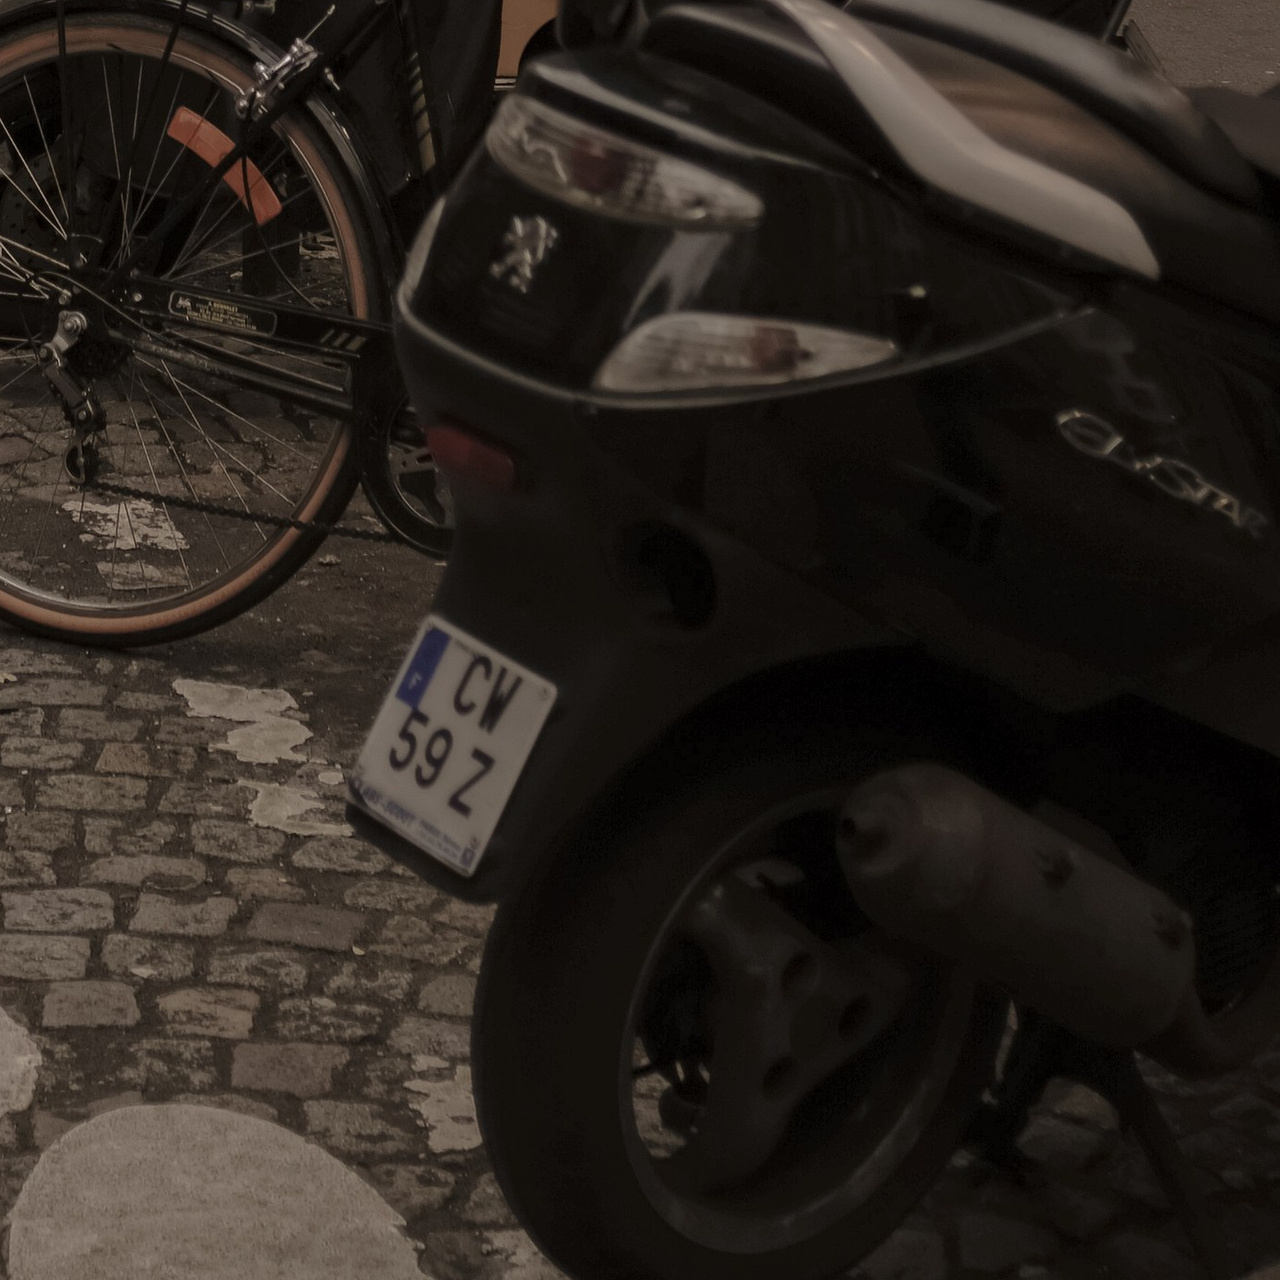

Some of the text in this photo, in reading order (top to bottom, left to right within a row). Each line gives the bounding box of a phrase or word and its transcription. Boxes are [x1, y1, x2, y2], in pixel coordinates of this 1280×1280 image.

[453, 655, 524, 735] CW
[388, 708, 496, 818] 59 Z
